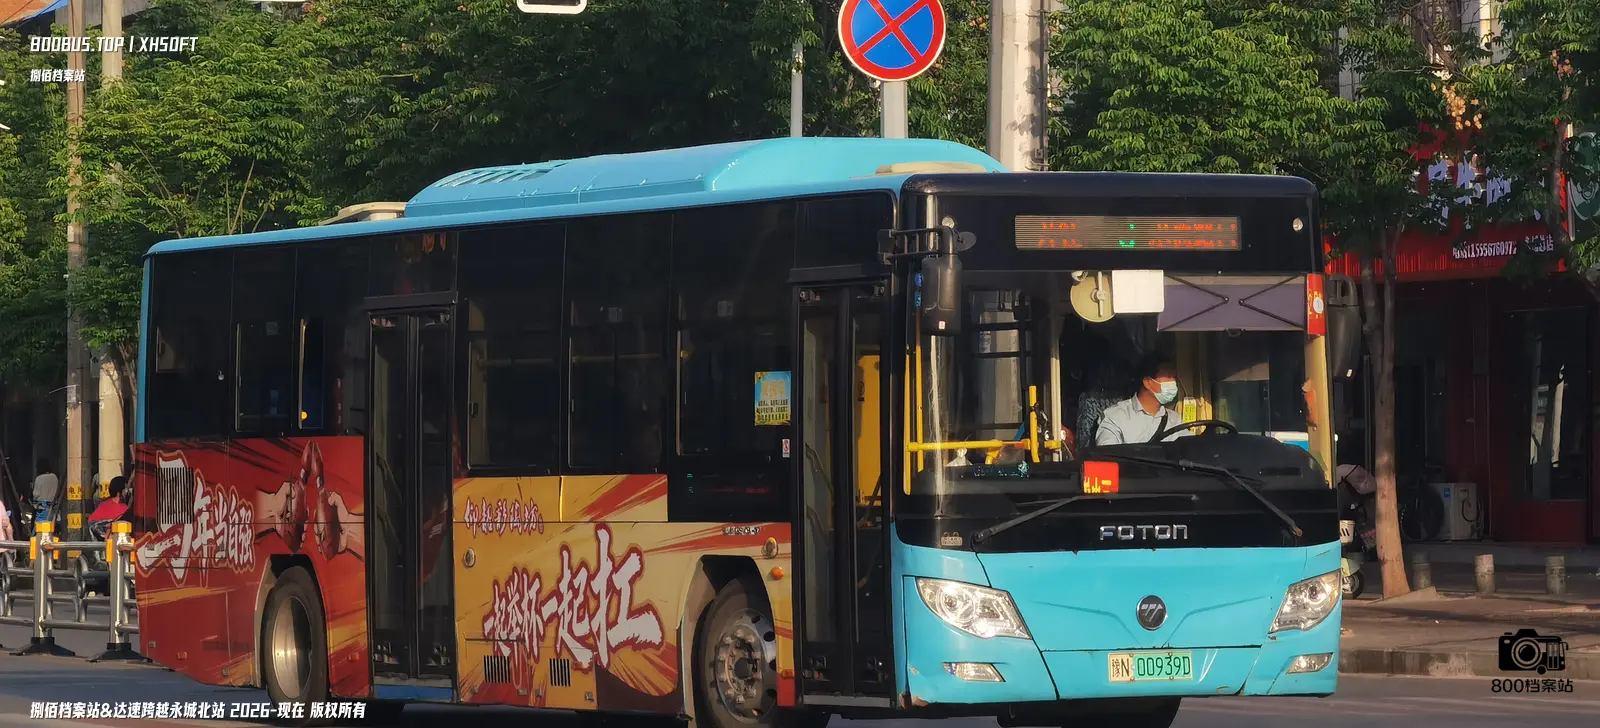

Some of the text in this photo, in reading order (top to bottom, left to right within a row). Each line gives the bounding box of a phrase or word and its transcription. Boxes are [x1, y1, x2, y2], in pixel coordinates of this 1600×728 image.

[1100, 524, 1188, 540] FOTON
[482, 525, 664, 672] 一起举杯一起扛
